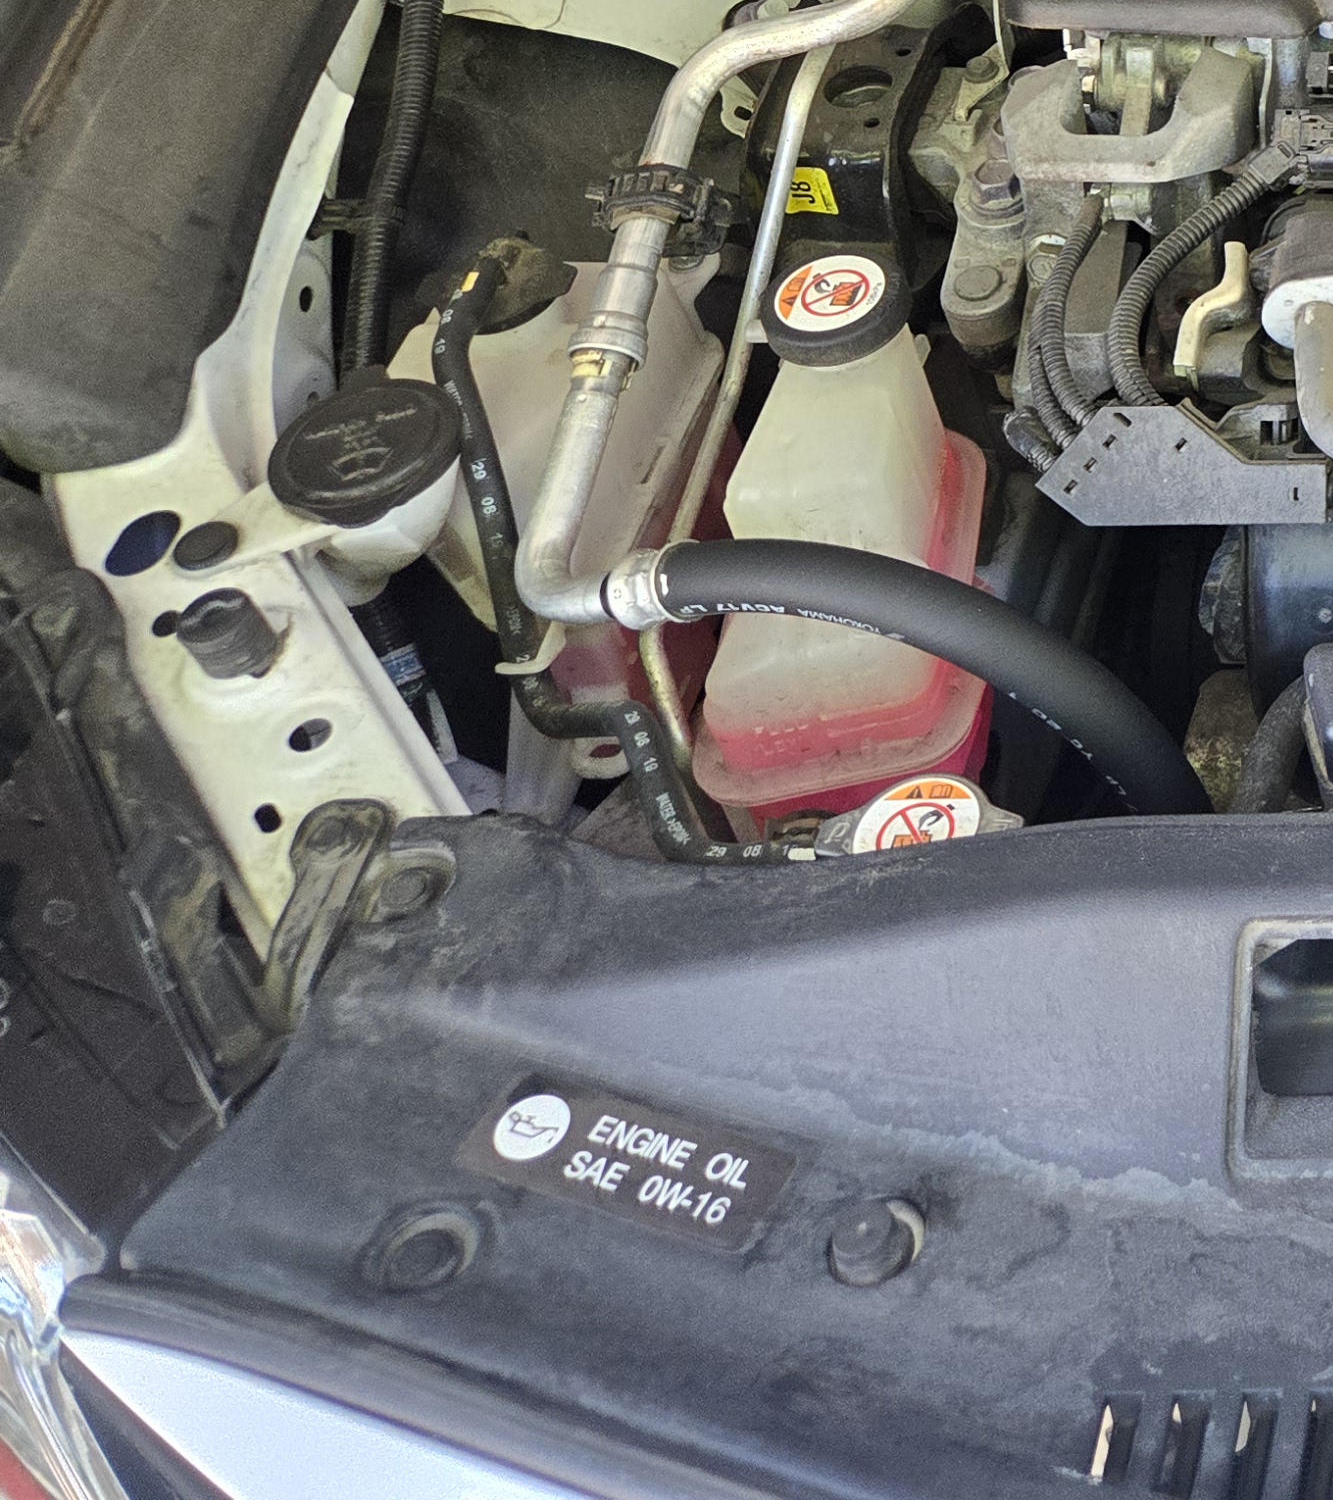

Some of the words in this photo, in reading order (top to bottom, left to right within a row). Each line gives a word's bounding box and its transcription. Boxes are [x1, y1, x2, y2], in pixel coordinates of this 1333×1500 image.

[790, 181, 816, 204] J8
[481, 497, 498, 515] 08
[797, 609, 880, 633] YOKOHAMA
[707, 845, 727, 858] 29
[742, 844, 762, 858] 08
[587, 1113, 698, 1170] ENGINE
[705, 1151, 752, 1190] OIL
[563, 1149, 631, 1192] SAE
[638, 1174, 733, 1225] 0W-16
